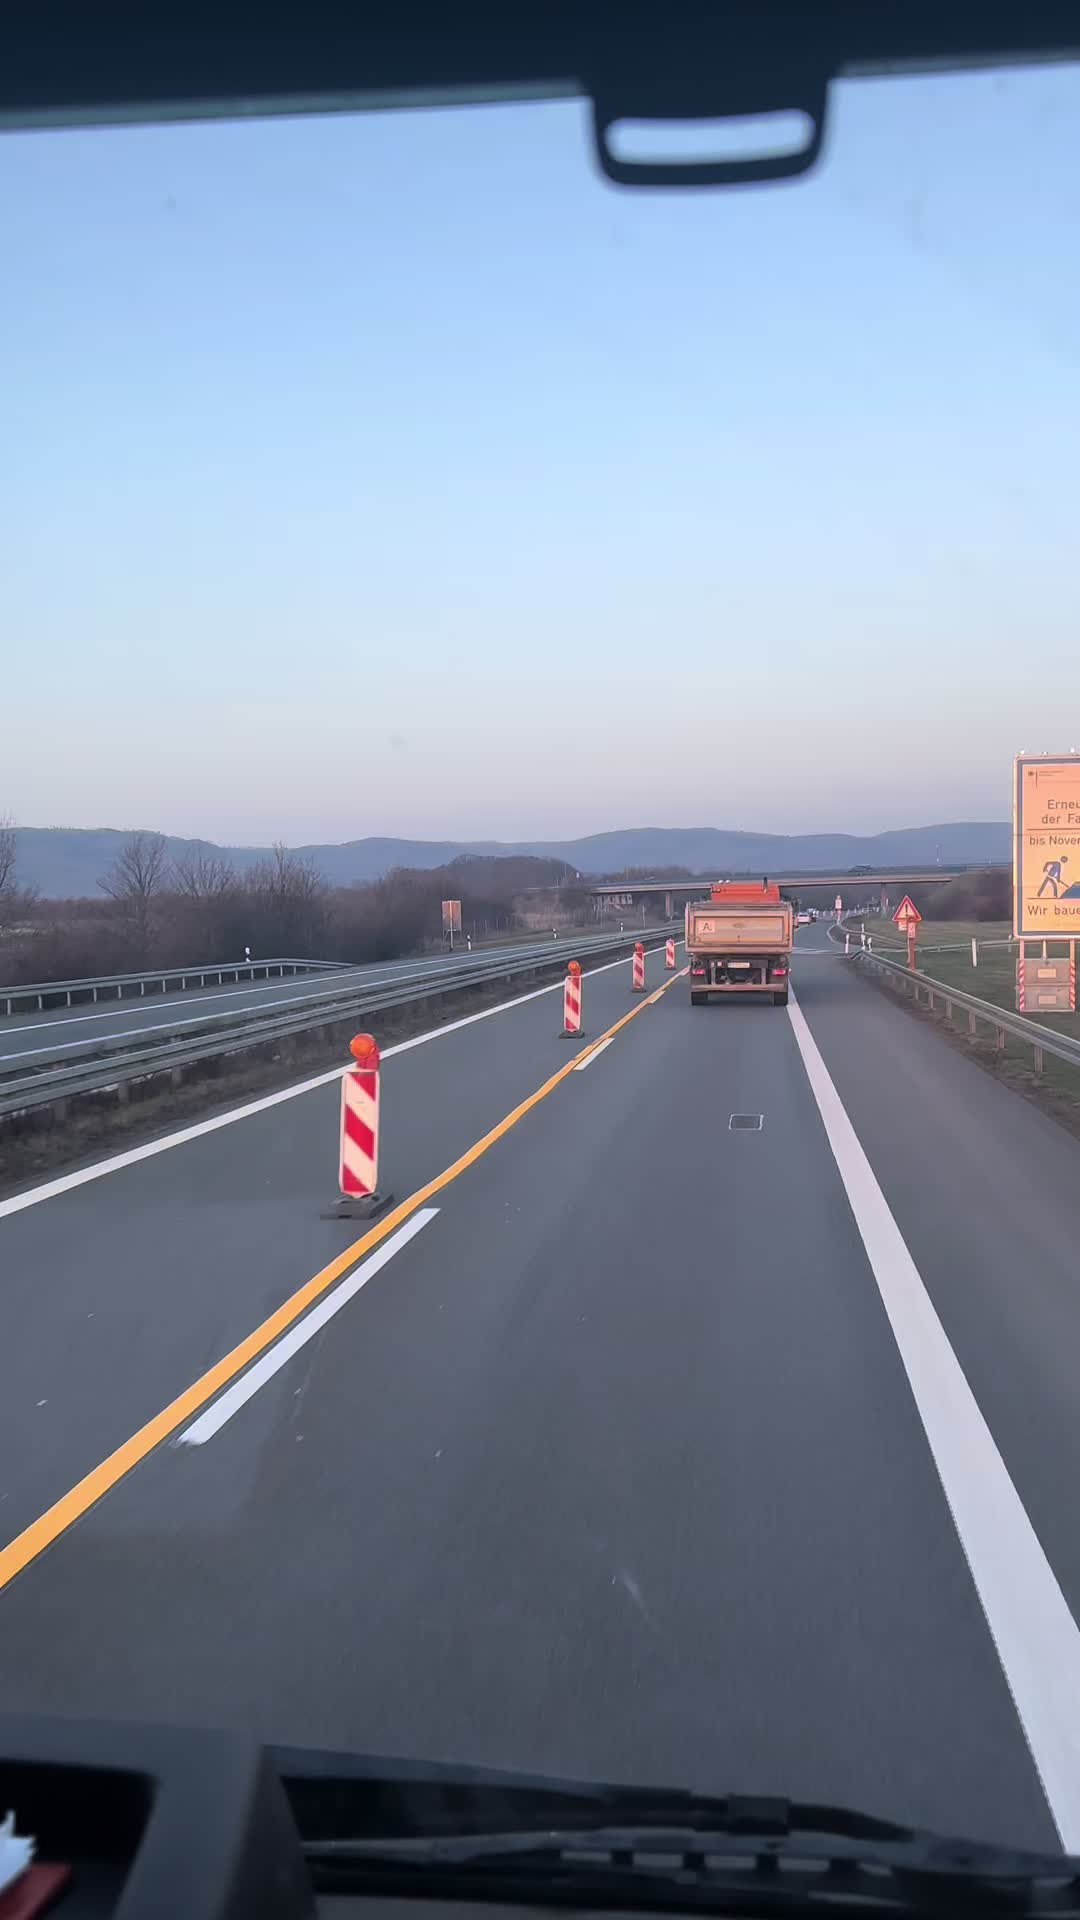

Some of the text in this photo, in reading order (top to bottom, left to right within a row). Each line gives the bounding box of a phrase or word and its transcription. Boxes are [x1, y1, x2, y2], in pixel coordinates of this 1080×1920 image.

[1041, 814, 1061, 824] der
[1029, 836, 1046, 846] bis
[1027, 904, 1048, 915] Wir
[702, 922, 712, 931] A
